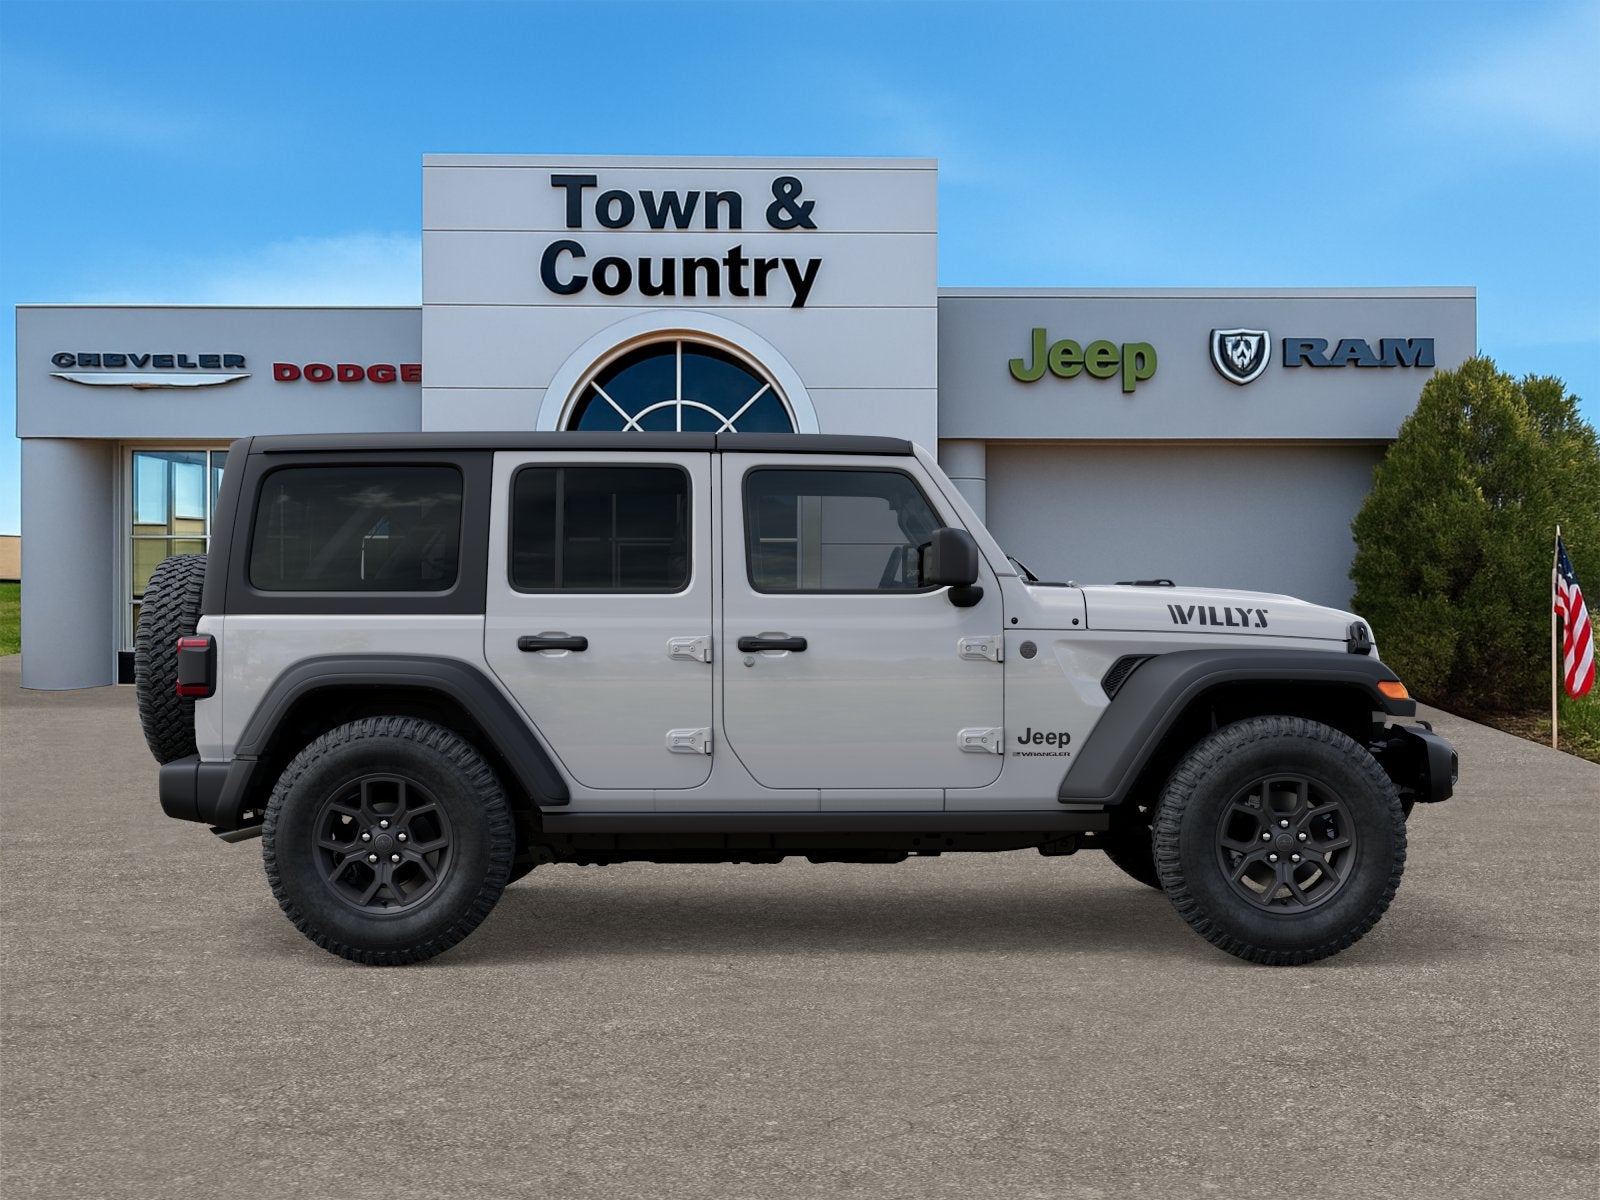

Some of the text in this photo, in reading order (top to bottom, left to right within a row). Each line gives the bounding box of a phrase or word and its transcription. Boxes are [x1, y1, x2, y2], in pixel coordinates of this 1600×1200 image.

[551, 174, 818, 230] Town &
[540, 239, 823, 308] Country
[1009, 327, 1158, 393] Jeep
[1282, 338, 1435, 368] RAM
[273, 363, 422, 383] DODGE
[1167, 604, 1268, 628] WILLYS
[1017, 727, 1071, 748] Jeep
